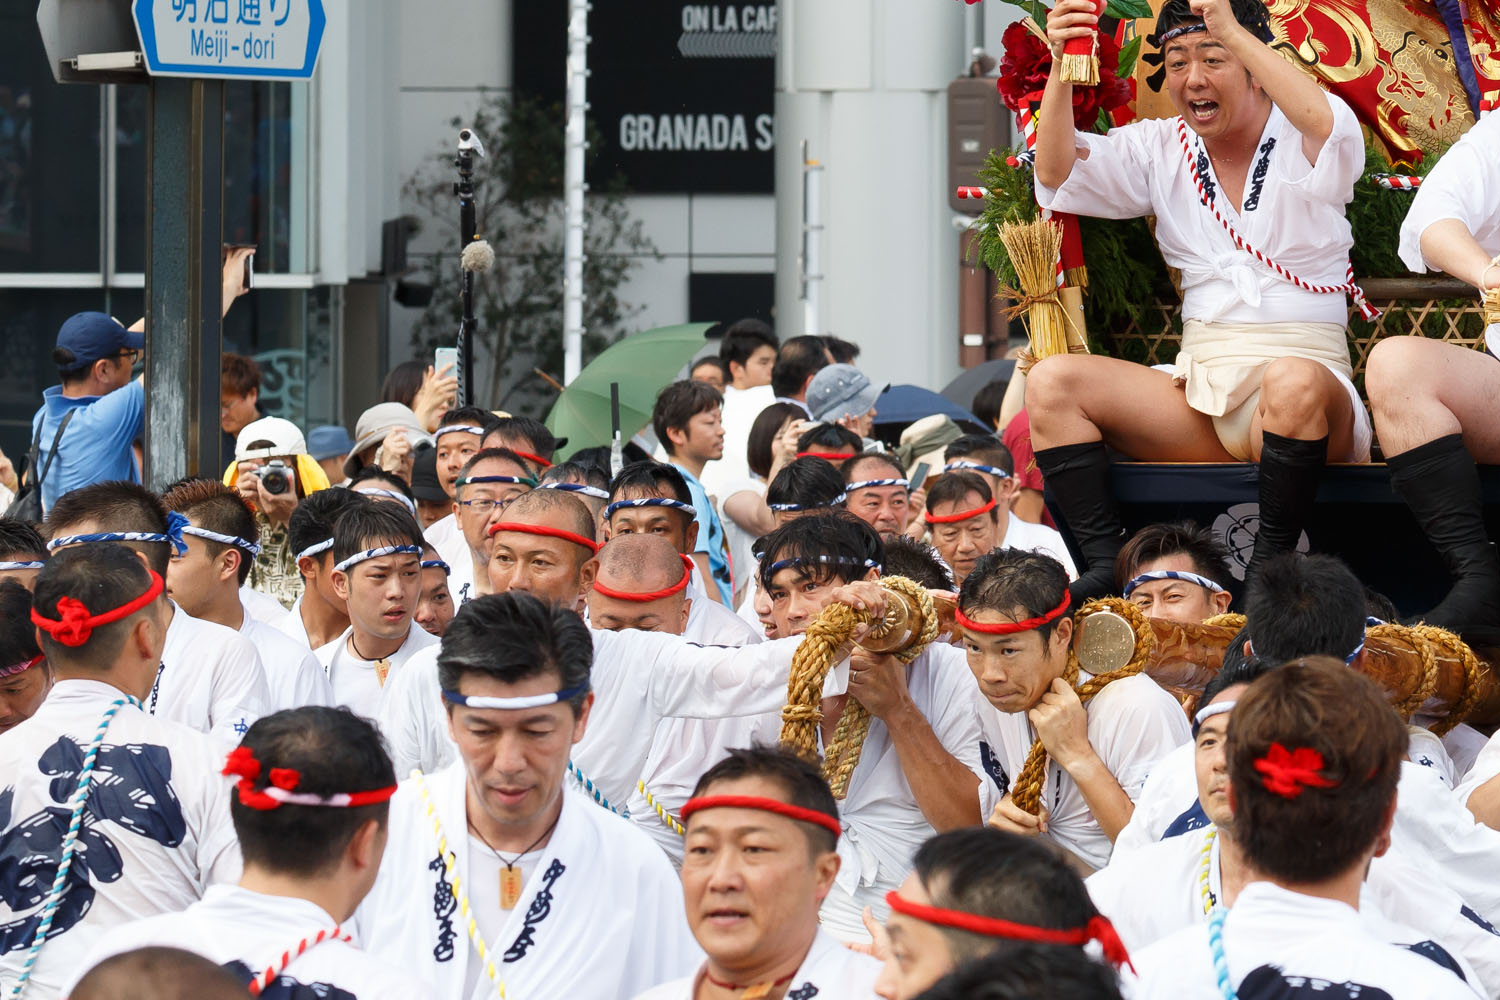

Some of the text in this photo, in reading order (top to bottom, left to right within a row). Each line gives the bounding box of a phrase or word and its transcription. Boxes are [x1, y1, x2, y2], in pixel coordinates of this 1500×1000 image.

[681, 5, 709, 32] ON
[712, 5, 738, 32] LA
[191, 29, 275, 63] Meiji-dori
[620, 114, 749, 151] GRANADA
